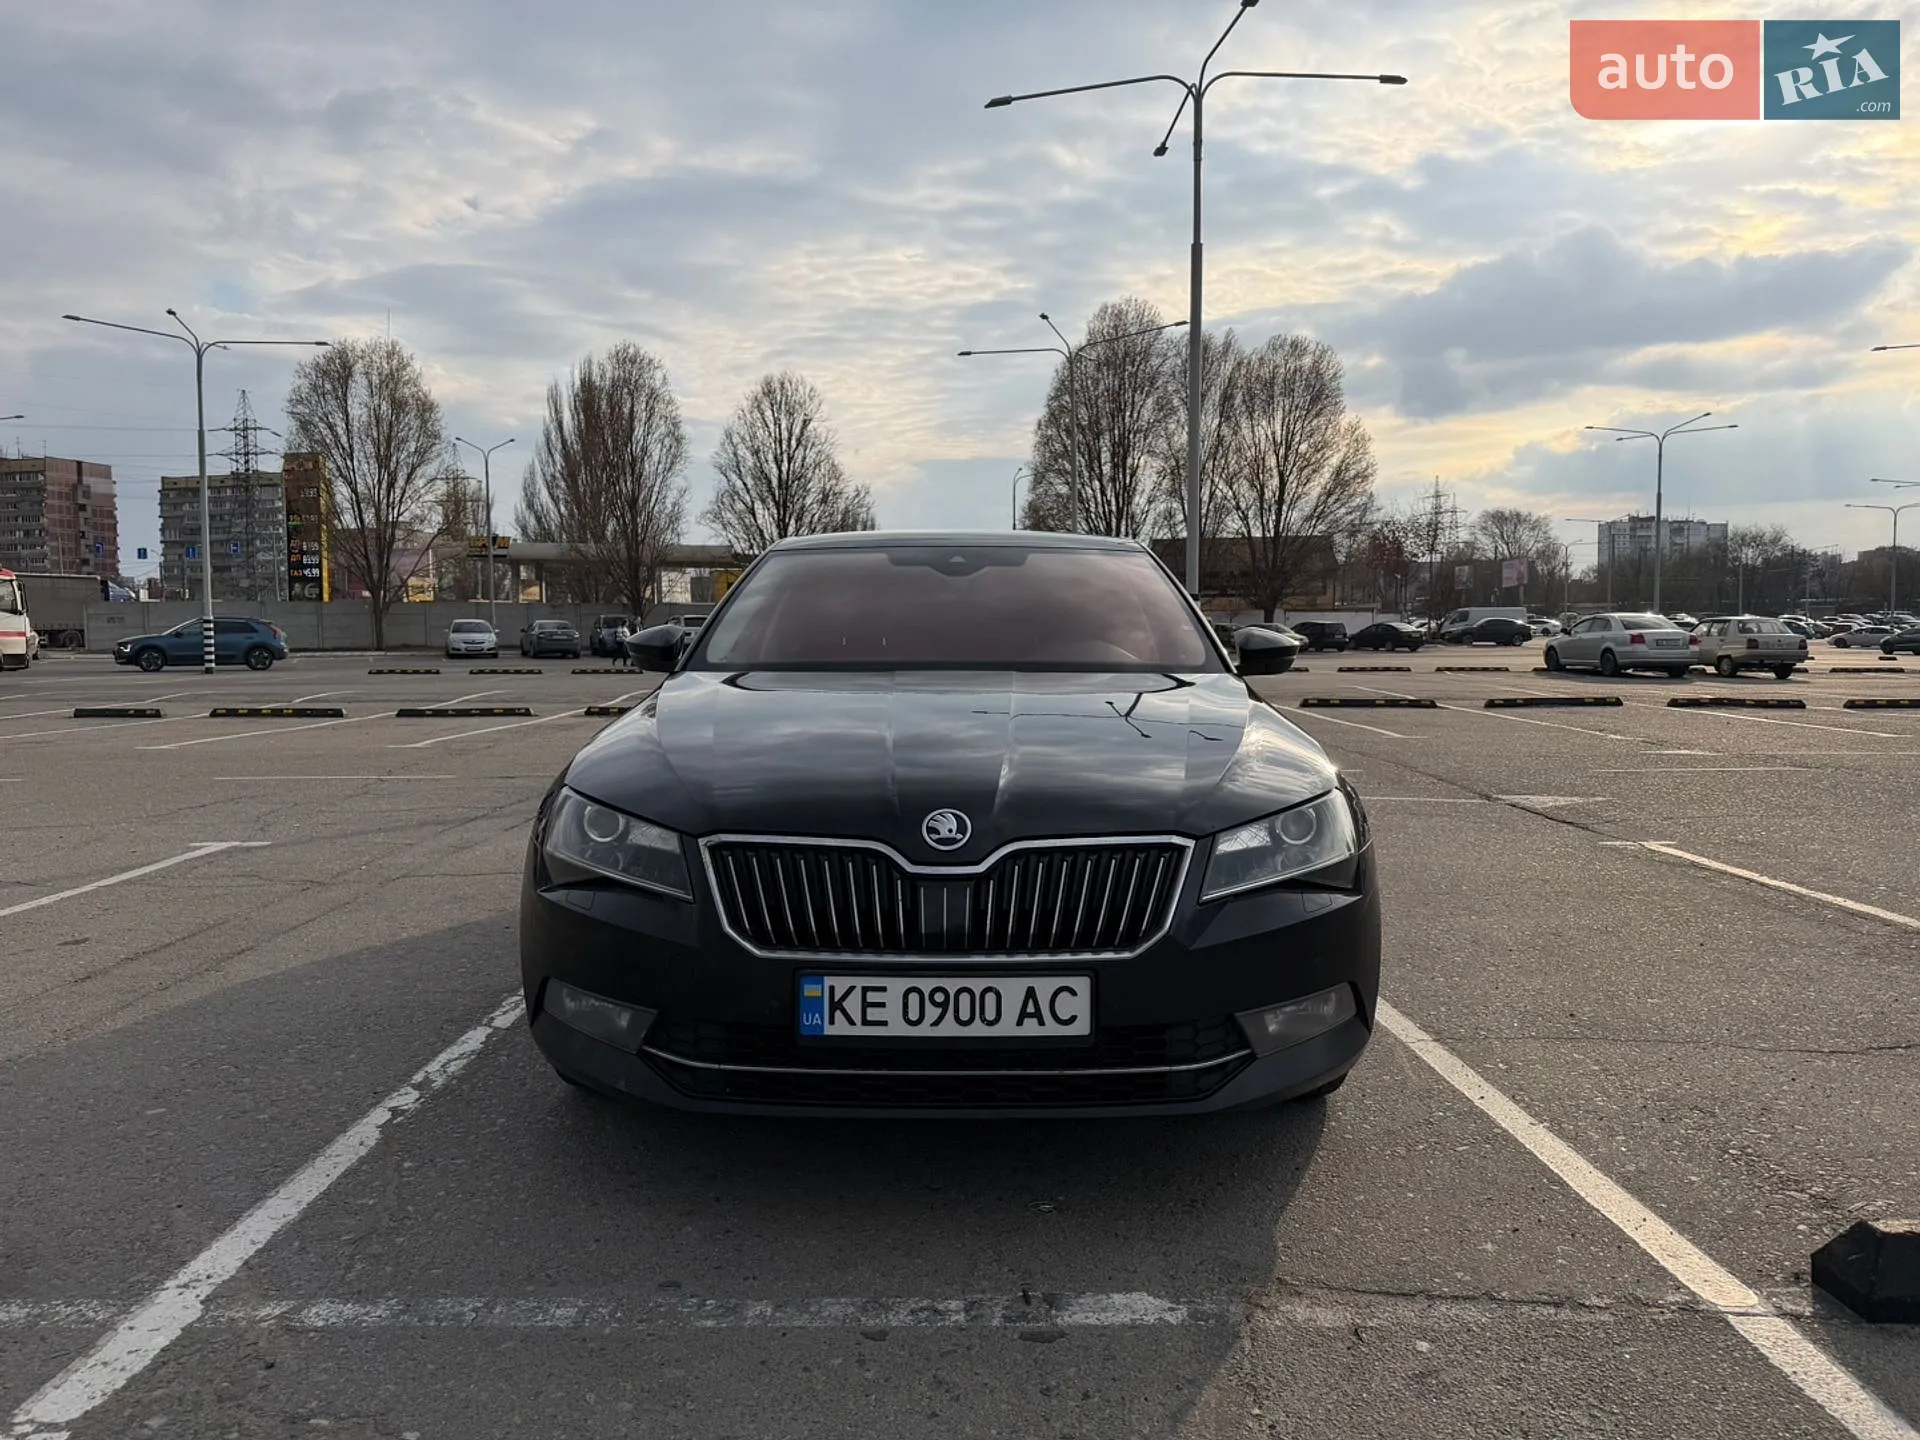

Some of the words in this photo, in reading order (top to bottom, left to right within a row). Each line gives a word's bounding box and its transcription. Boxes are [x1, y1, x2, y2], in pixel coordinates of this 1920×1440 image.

[803, 1013, 822, 1026] UA
[828, 985, 888, 1027] KE
[902, 986, 1002, 1027] 0900
[1016, 985, 1078, 1027] AC
